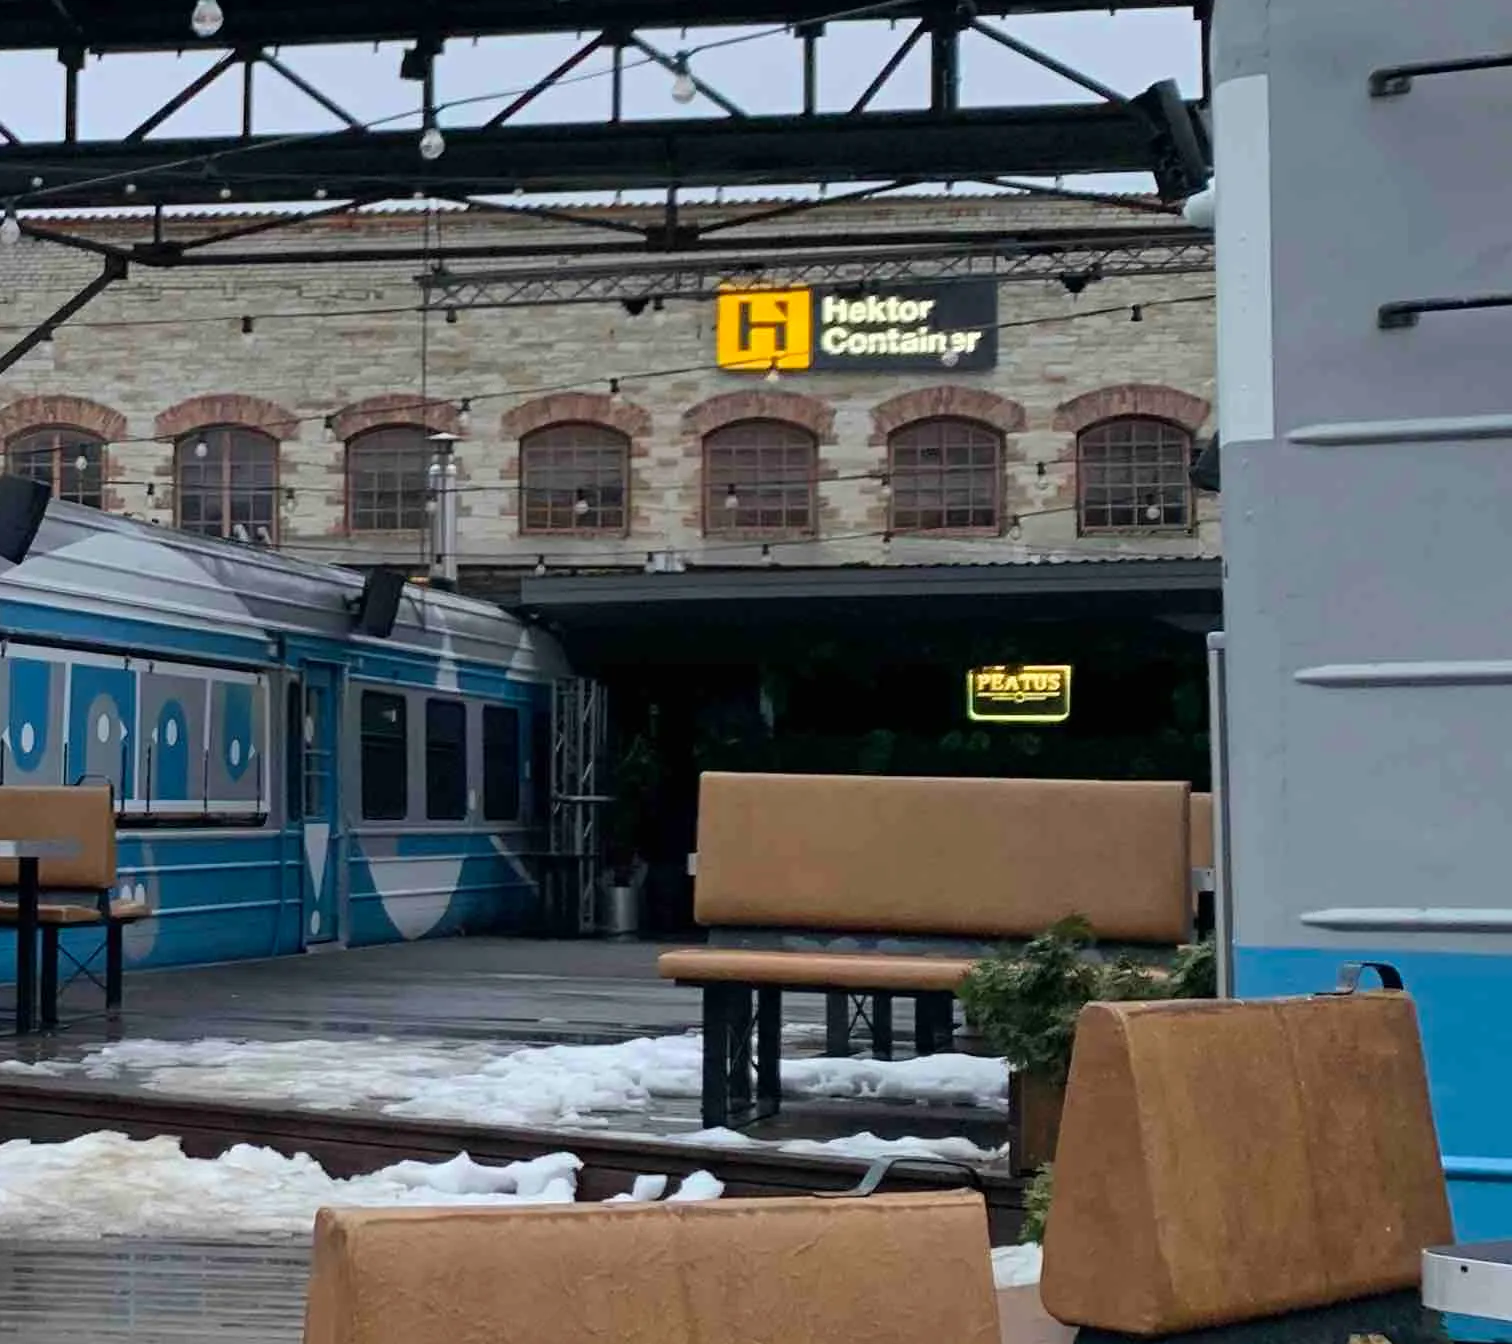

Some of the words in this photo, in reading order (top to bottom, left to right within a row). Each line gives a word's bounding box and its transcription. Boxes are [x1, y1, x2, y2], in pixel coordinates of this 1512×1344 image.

[821, 296, 934, 323] Hektor
[739, 301, 787, 351] H
[821, 327, 983, 354] Container
[976, 673, 1061, 691] PEATUS
